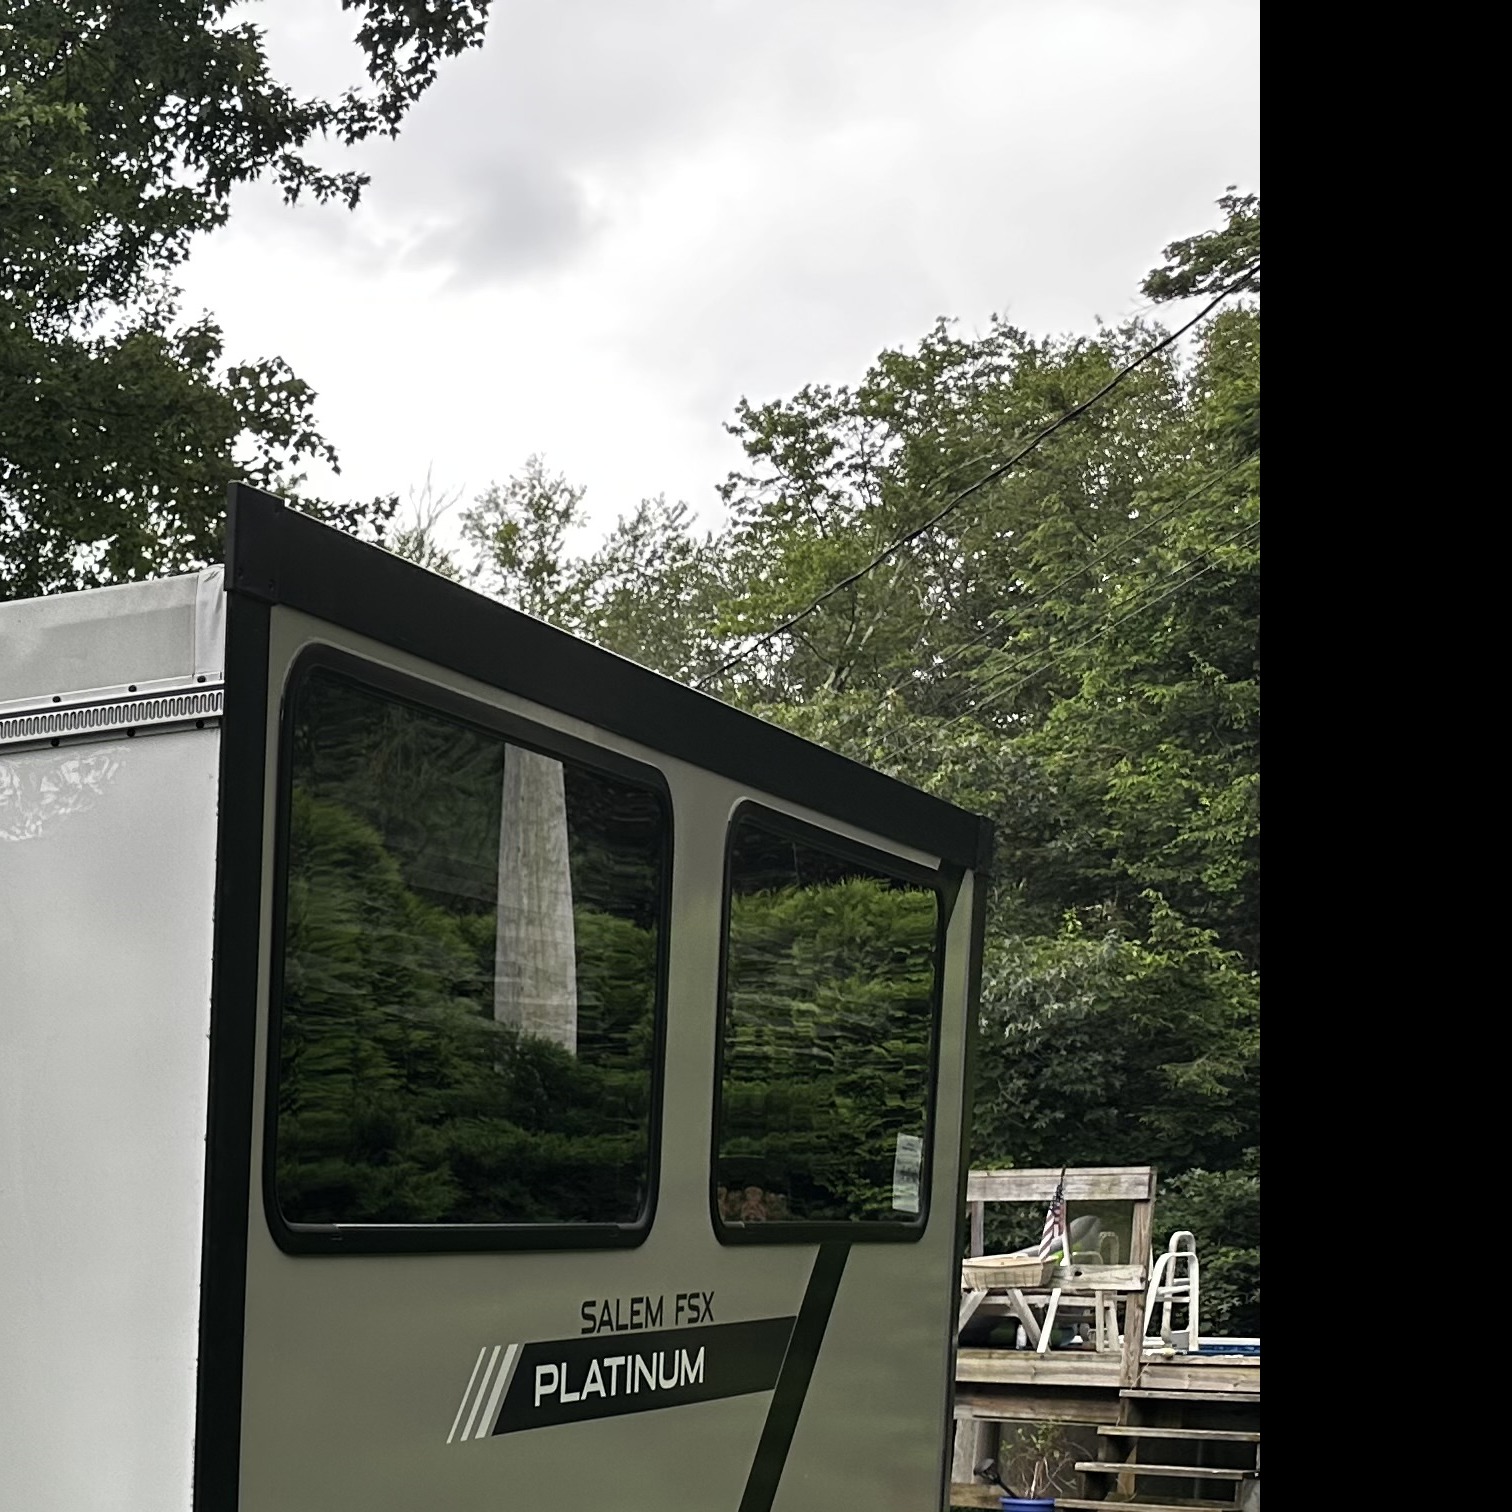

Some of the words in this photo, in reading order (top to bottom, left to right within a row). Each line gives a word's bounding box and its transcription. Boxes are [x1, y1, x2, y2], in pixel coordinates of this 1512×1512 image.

[580, 1295, 664, 1335] SALEM
[675, 1291, 715, 1326] FSX
[534, 1346, 706, 1407] PLATINUM
